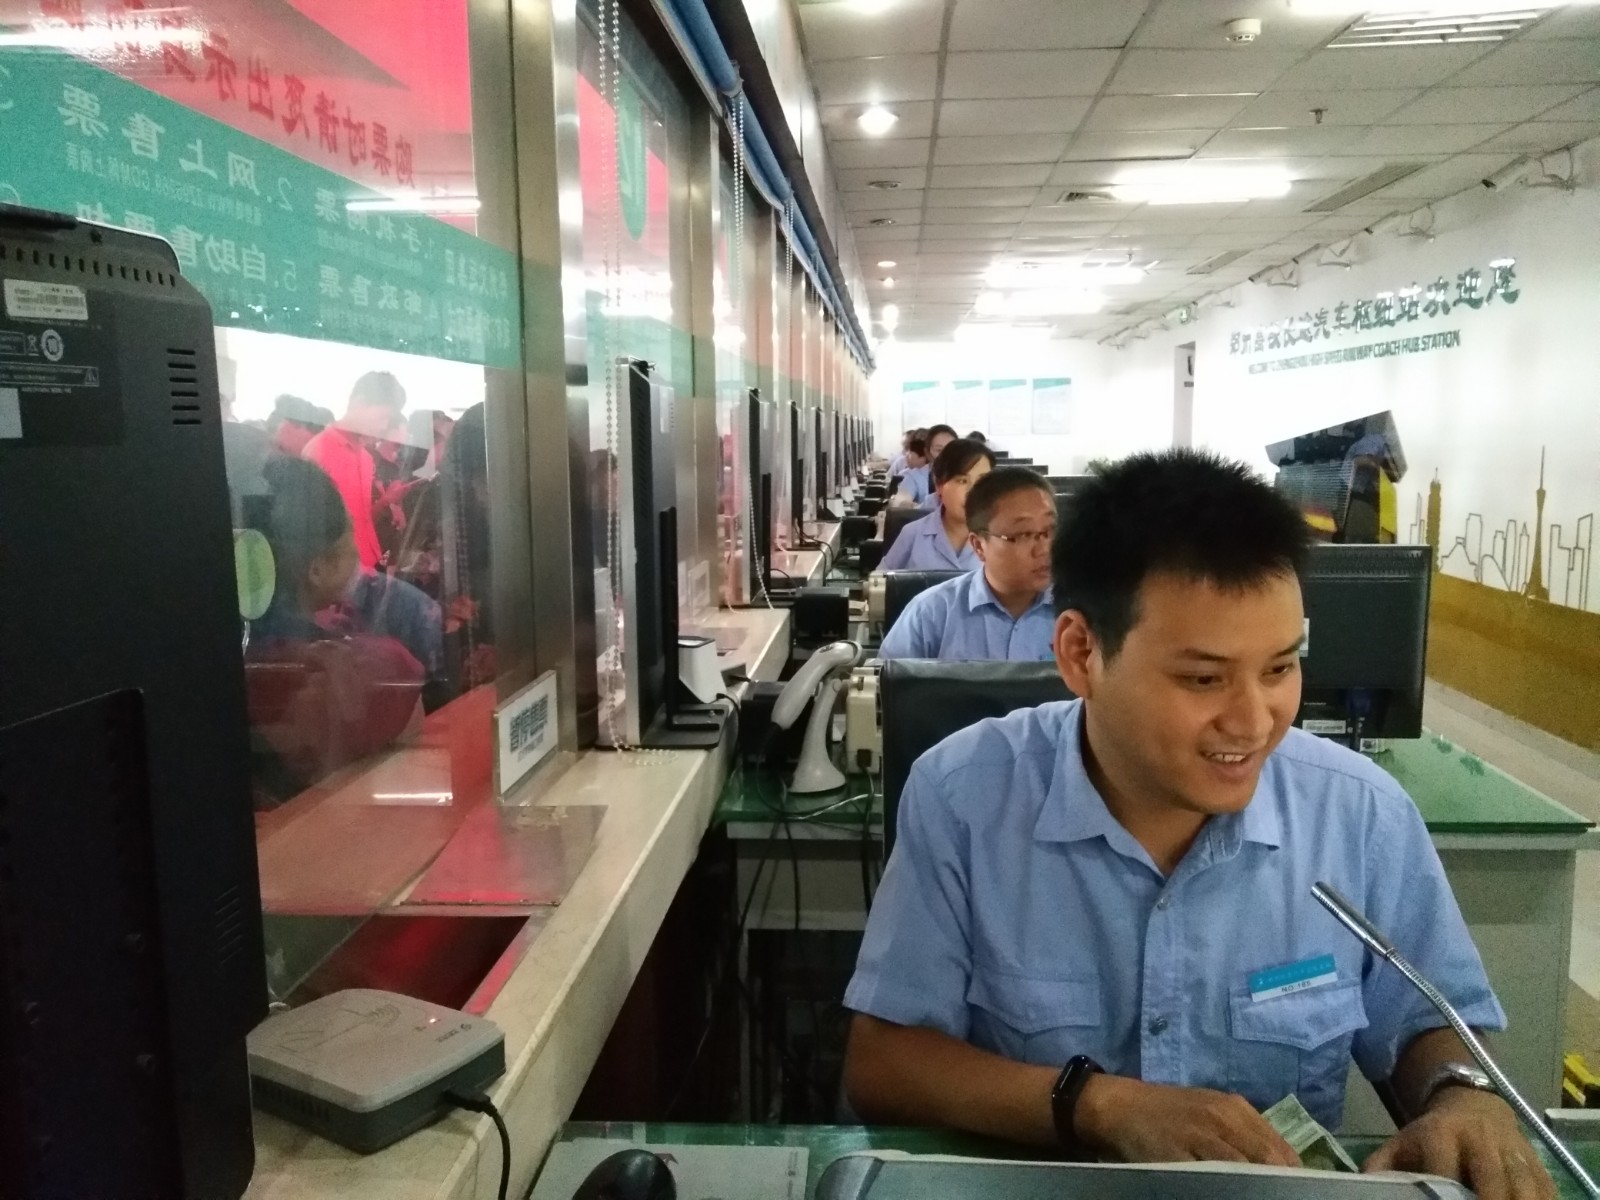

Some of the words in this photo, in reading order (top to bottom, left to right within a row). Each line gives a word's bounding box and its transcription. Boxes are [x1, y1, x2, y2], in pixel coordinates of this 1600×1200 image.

[1374, 339, 1400, 357] COACH
[1402, 336, 1420, 353] HUB
[1422, 329, 1460, 351] STATION
